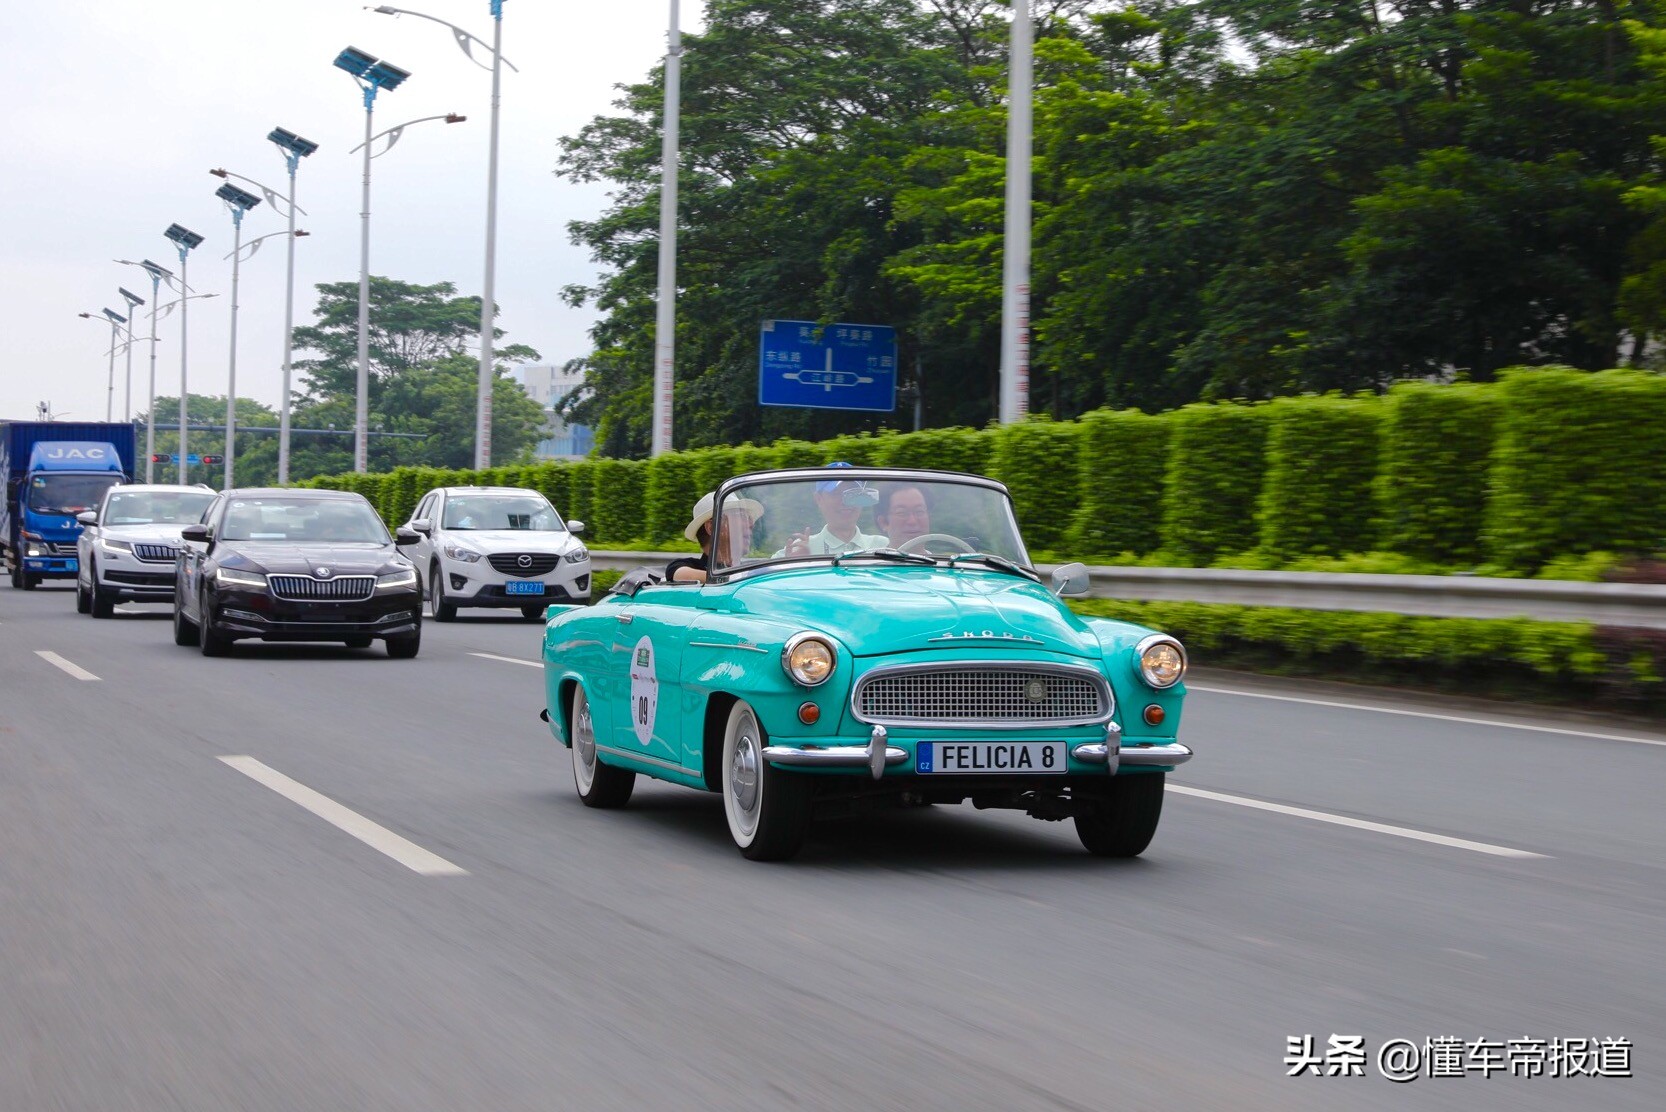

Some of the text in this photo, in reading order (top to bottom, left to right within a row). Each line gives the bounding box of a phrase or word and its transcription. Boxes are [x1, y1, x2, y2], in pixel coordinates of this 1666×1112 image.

[47, 448, 104, 459] JAC
[638, 696, 648, 726] 09
[942, 745, 1055, 769] FELICIA 8
[920, 762, 930, 770] CZ
